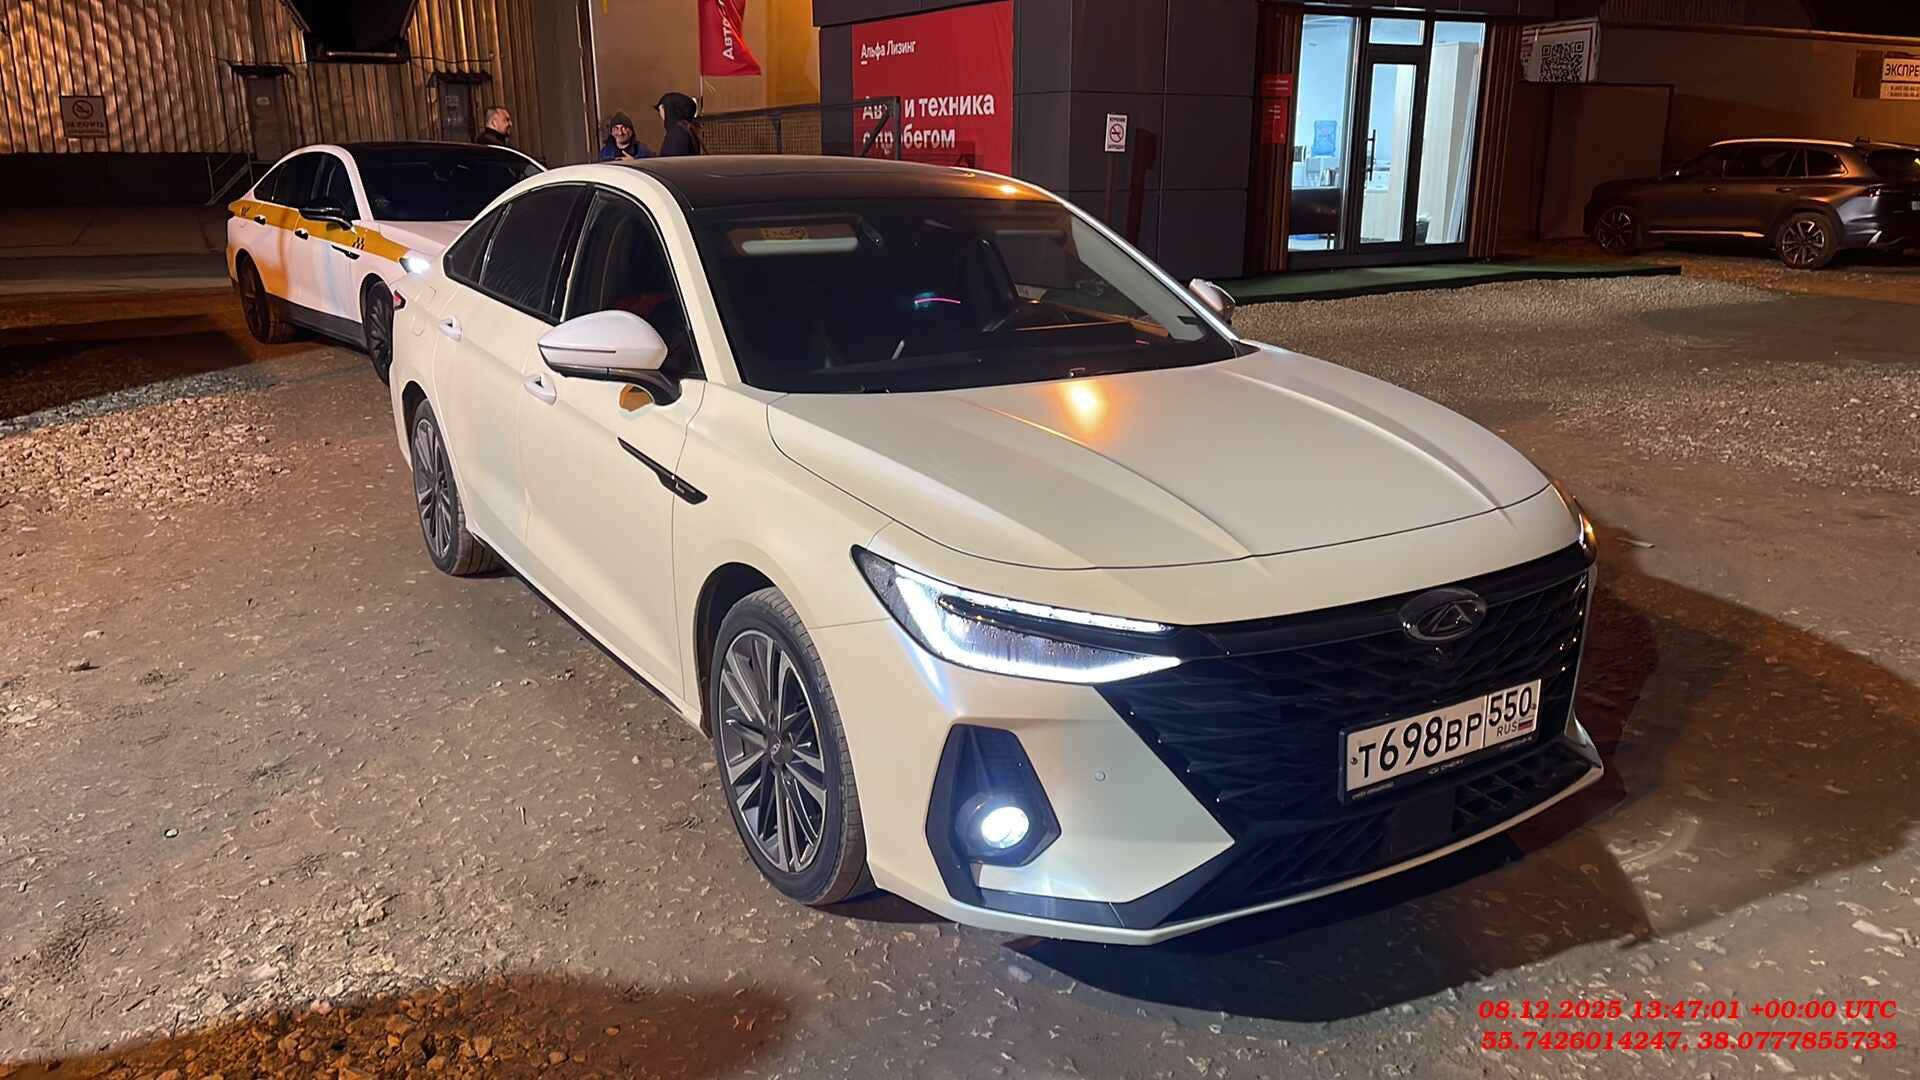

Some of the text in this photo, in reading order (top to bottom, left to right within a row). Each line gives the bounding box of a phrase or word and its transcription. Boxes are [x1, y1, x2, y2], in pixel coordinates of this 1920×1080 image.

[860, 40, 917, 61] Альфа Лизинг
[904, 99, 915, 118] и
[918, 94, 996, 118] техника
[875, 123, 956, 156] прбегом
[1358, 686, 1533, 778] Т698ВР 550
[1496, 720, 1519, 737] RUS
